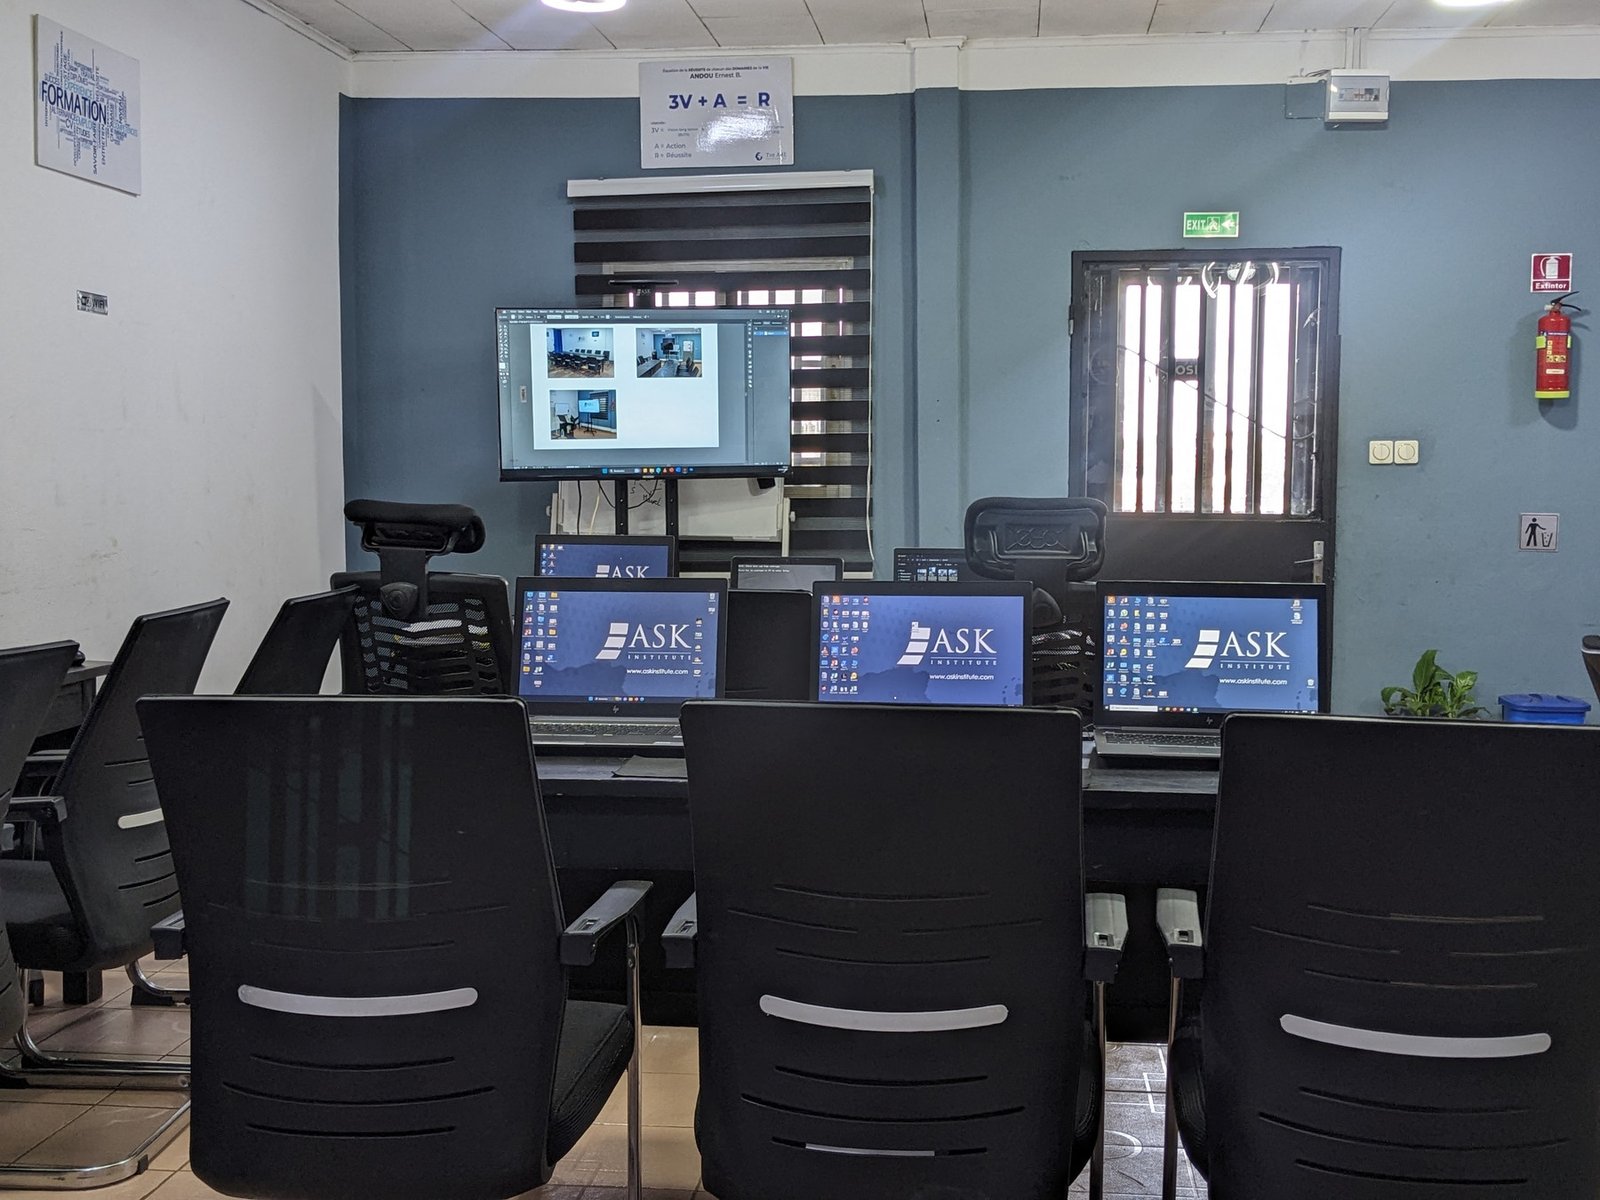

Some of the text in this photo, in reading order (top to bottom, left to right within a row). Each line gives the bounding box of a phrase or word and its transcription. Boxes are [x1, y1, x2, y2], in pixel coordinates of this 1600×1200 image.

[41, 80, 107, 125] FORMATION
[668, 94, 693, 109] 3V
[713, 93, 727, 108] A
[758, 92, 771, 107] R
[65, 118, 73, 130] CV
[1186, 219, 1207, 231] EXIT
[1535, 282, 1567, 290] Extintor
[612, 565, 650, 578] ASK
[628, 623, 692, 649] ASK
[930, 628, 997, 654] ASK
[1219, 631, 1290, 658] ASK
[626, 668, 689, 676] www.askinstitute.com
[929, 673, 994, 681] www.askinstitute.com
[1219, 677, 1288, 686] www.askinstitute.com
